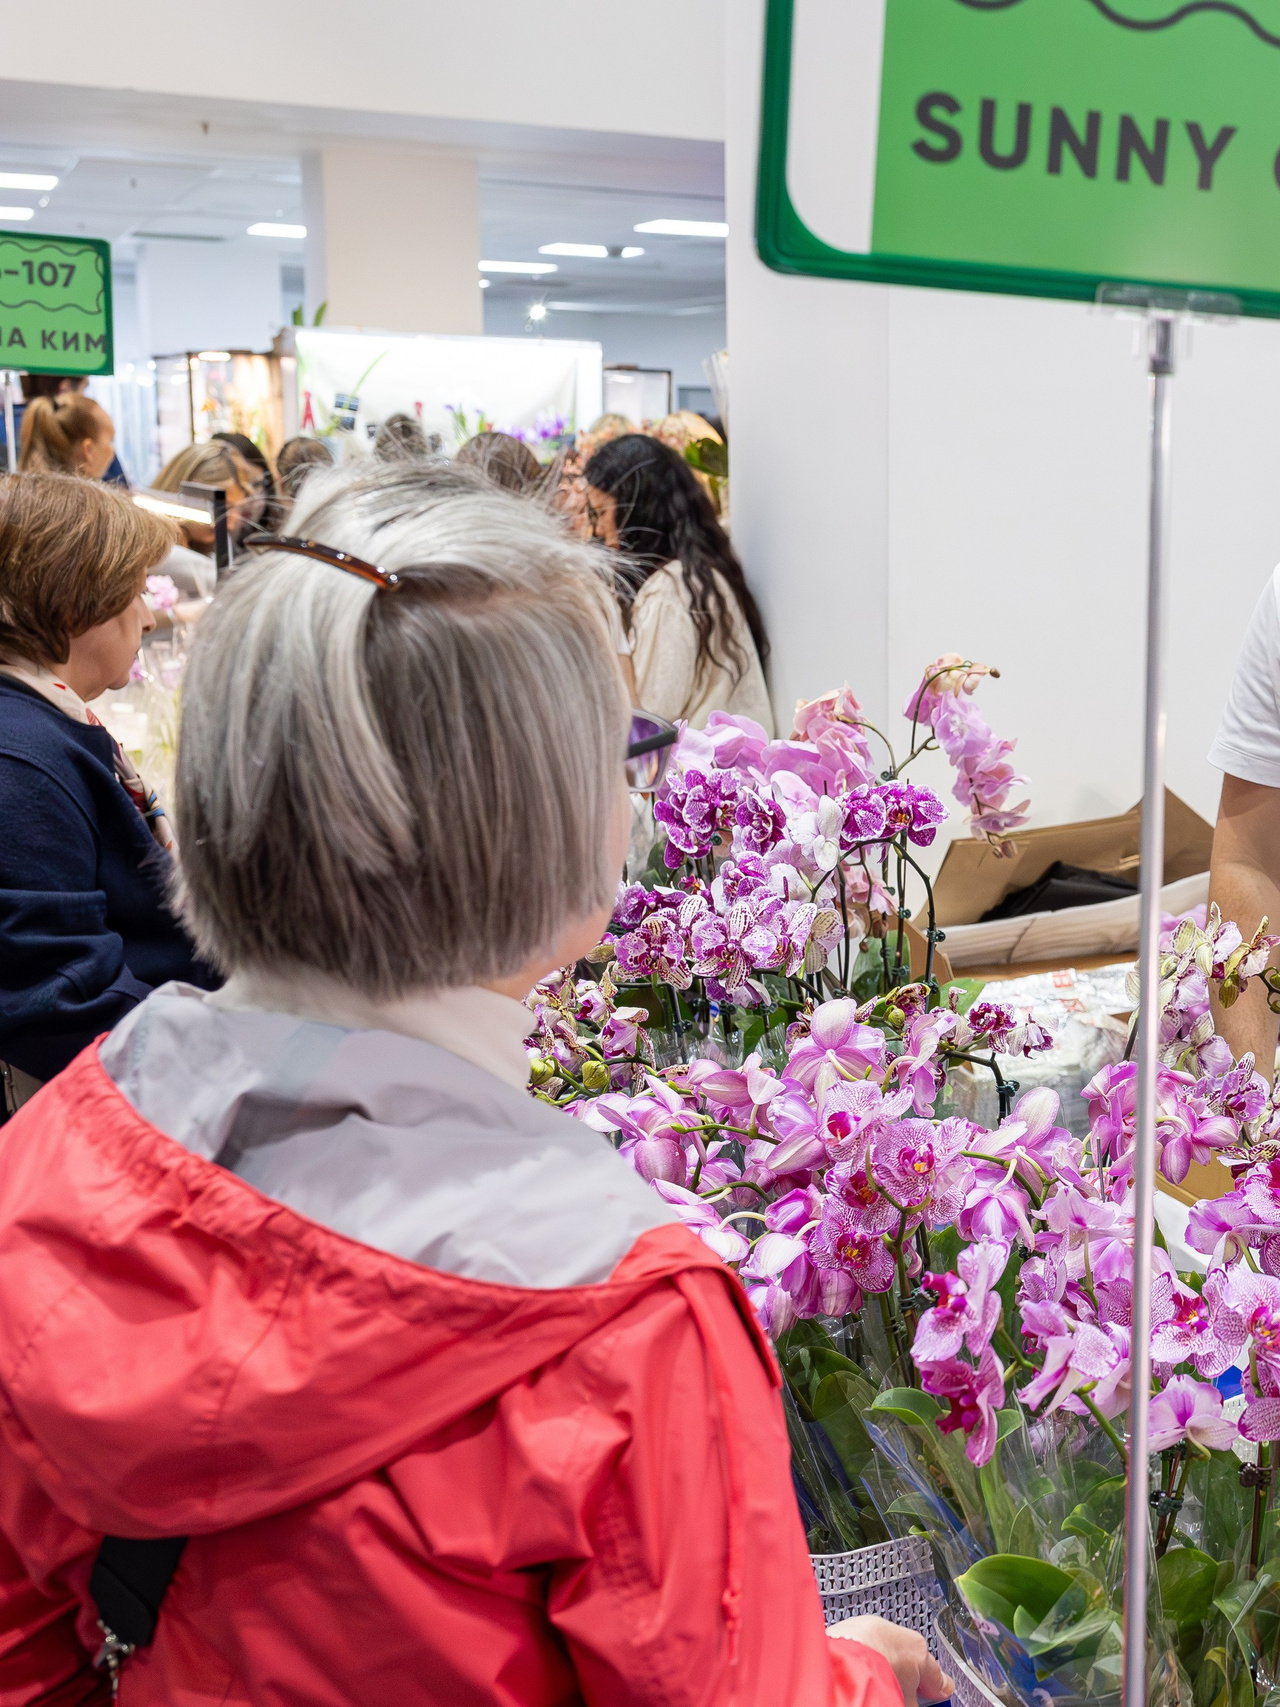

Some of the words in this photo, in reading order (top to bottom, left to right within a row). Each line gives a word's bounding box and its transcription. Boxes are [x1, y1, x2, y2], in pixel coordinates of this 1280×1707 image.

[911, 90, 1238, 192] SUNNY
[0, 259, 77, 288] -107
[41, 329, 107, 353] КИМ
